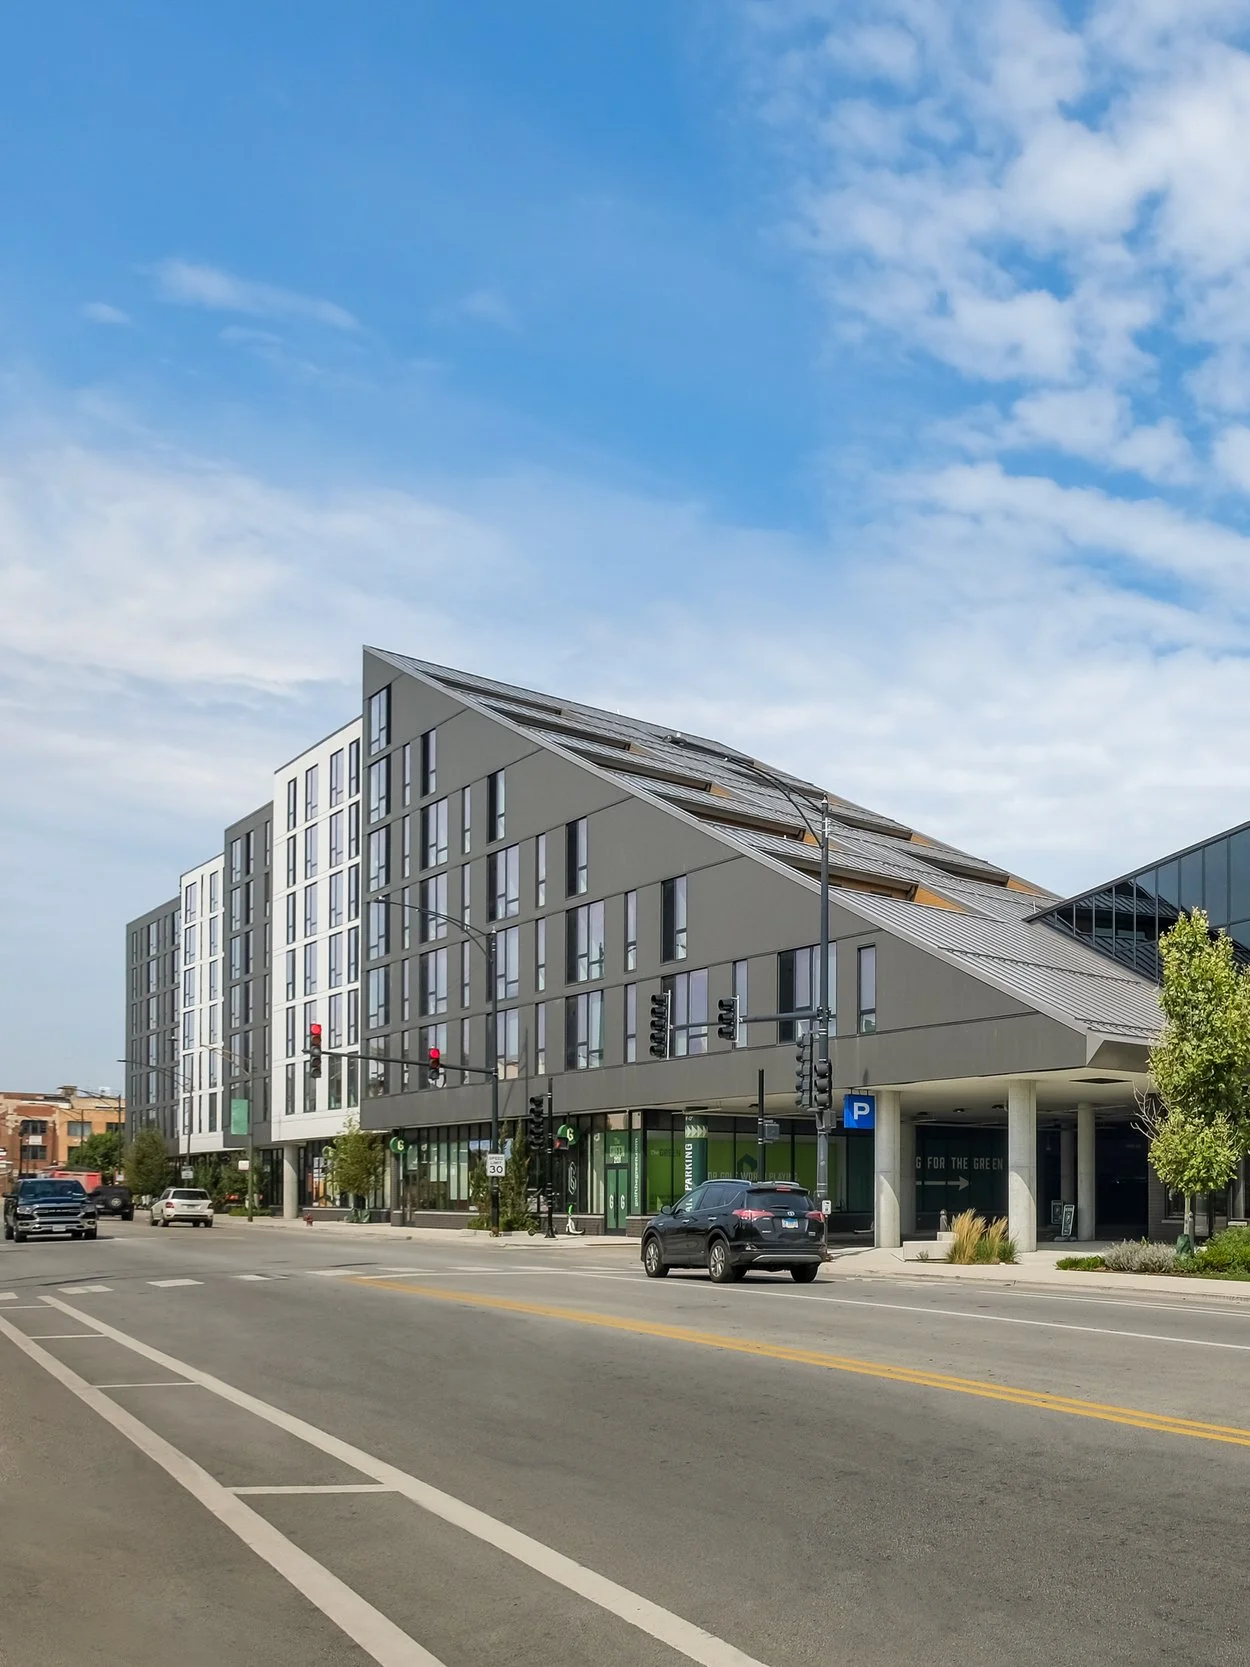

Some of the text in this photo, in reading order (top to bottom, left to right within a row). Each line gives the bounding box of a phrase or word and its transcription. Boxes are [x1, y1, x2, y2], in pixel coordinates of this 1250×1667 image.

[853, 1102, 870, 1120] P
[567, 1127, 574, 1141] G
[489, 1165, 503, 1174] 30
[684, 1143, 693, 1191] PARKING
[927, 1156, 945, 1169] FOR
[951, 1157, 968, 1169] THE
[973, 1157, 1003, 1170] GREEN
